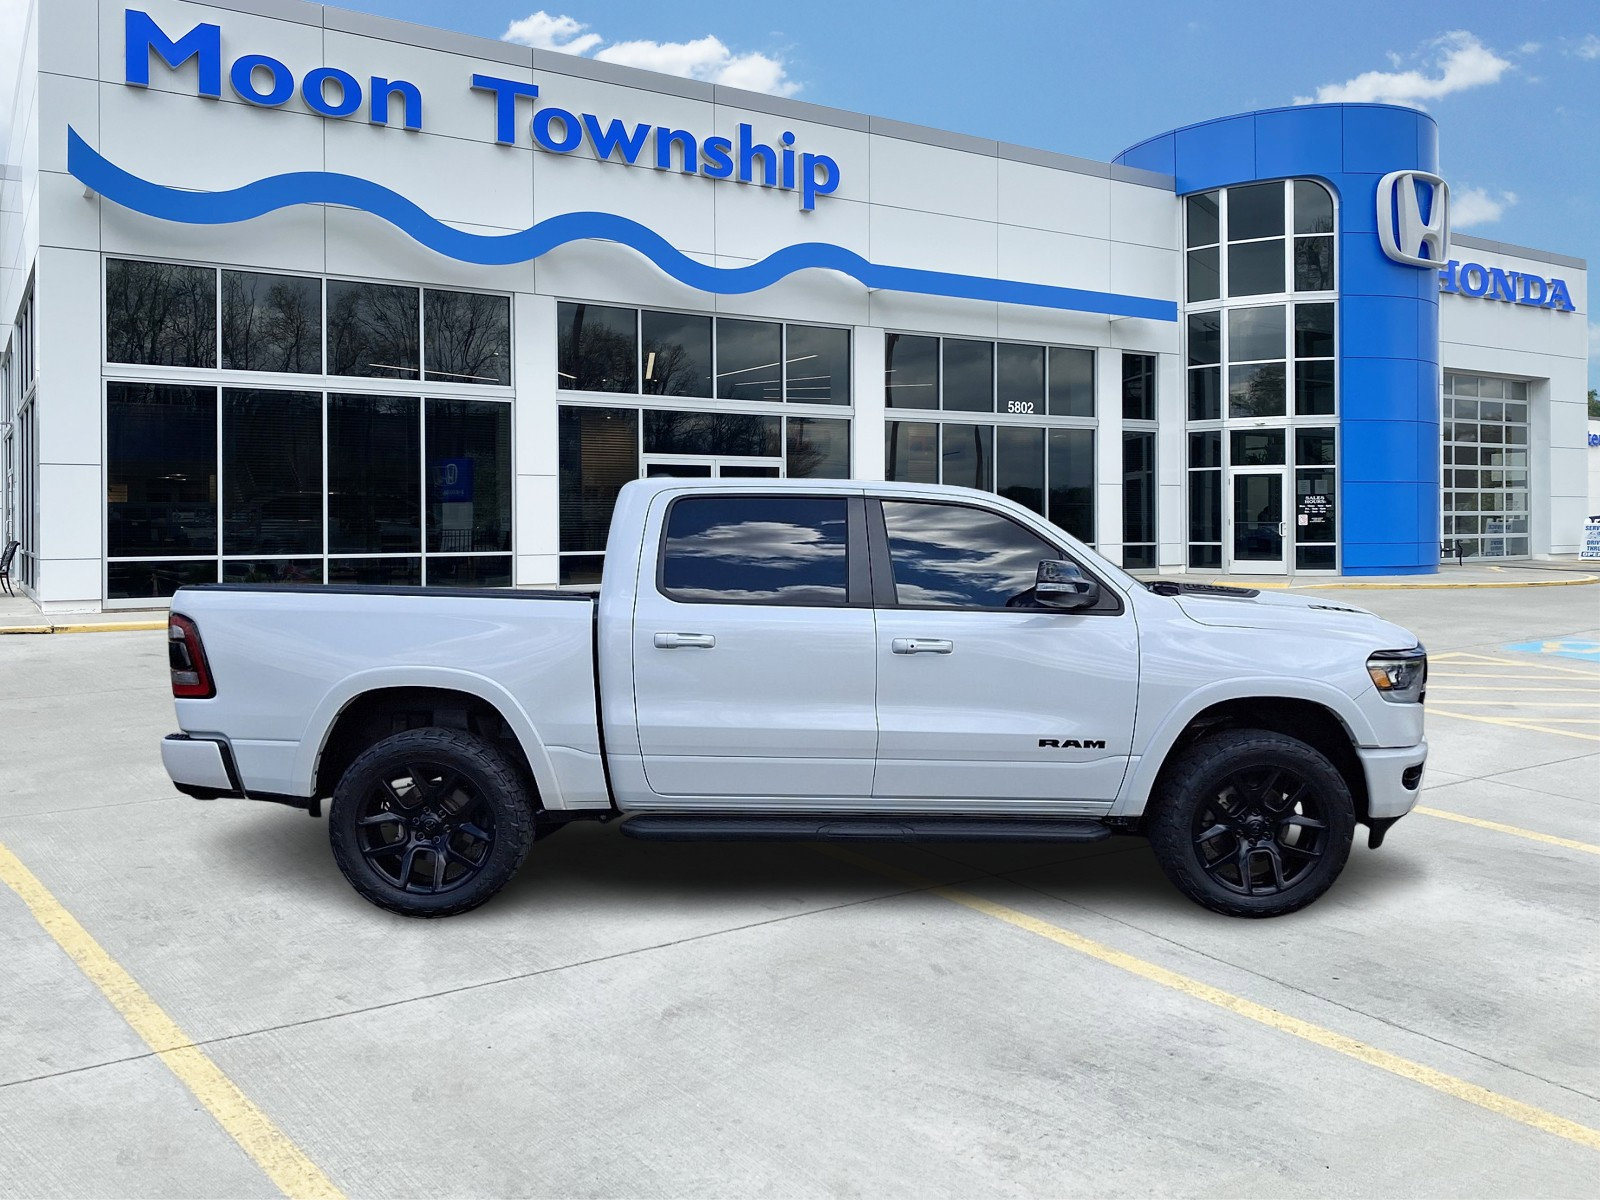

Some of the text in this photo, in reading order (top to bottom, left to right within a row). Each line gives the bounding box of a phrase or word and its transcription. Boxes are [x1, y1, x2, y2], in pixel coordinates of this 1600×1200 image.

[125, 8, 841, 212] Moon Township
[1007, 400, 1034, 414] 5802
[1038, 739, 1106, 749] RAM
